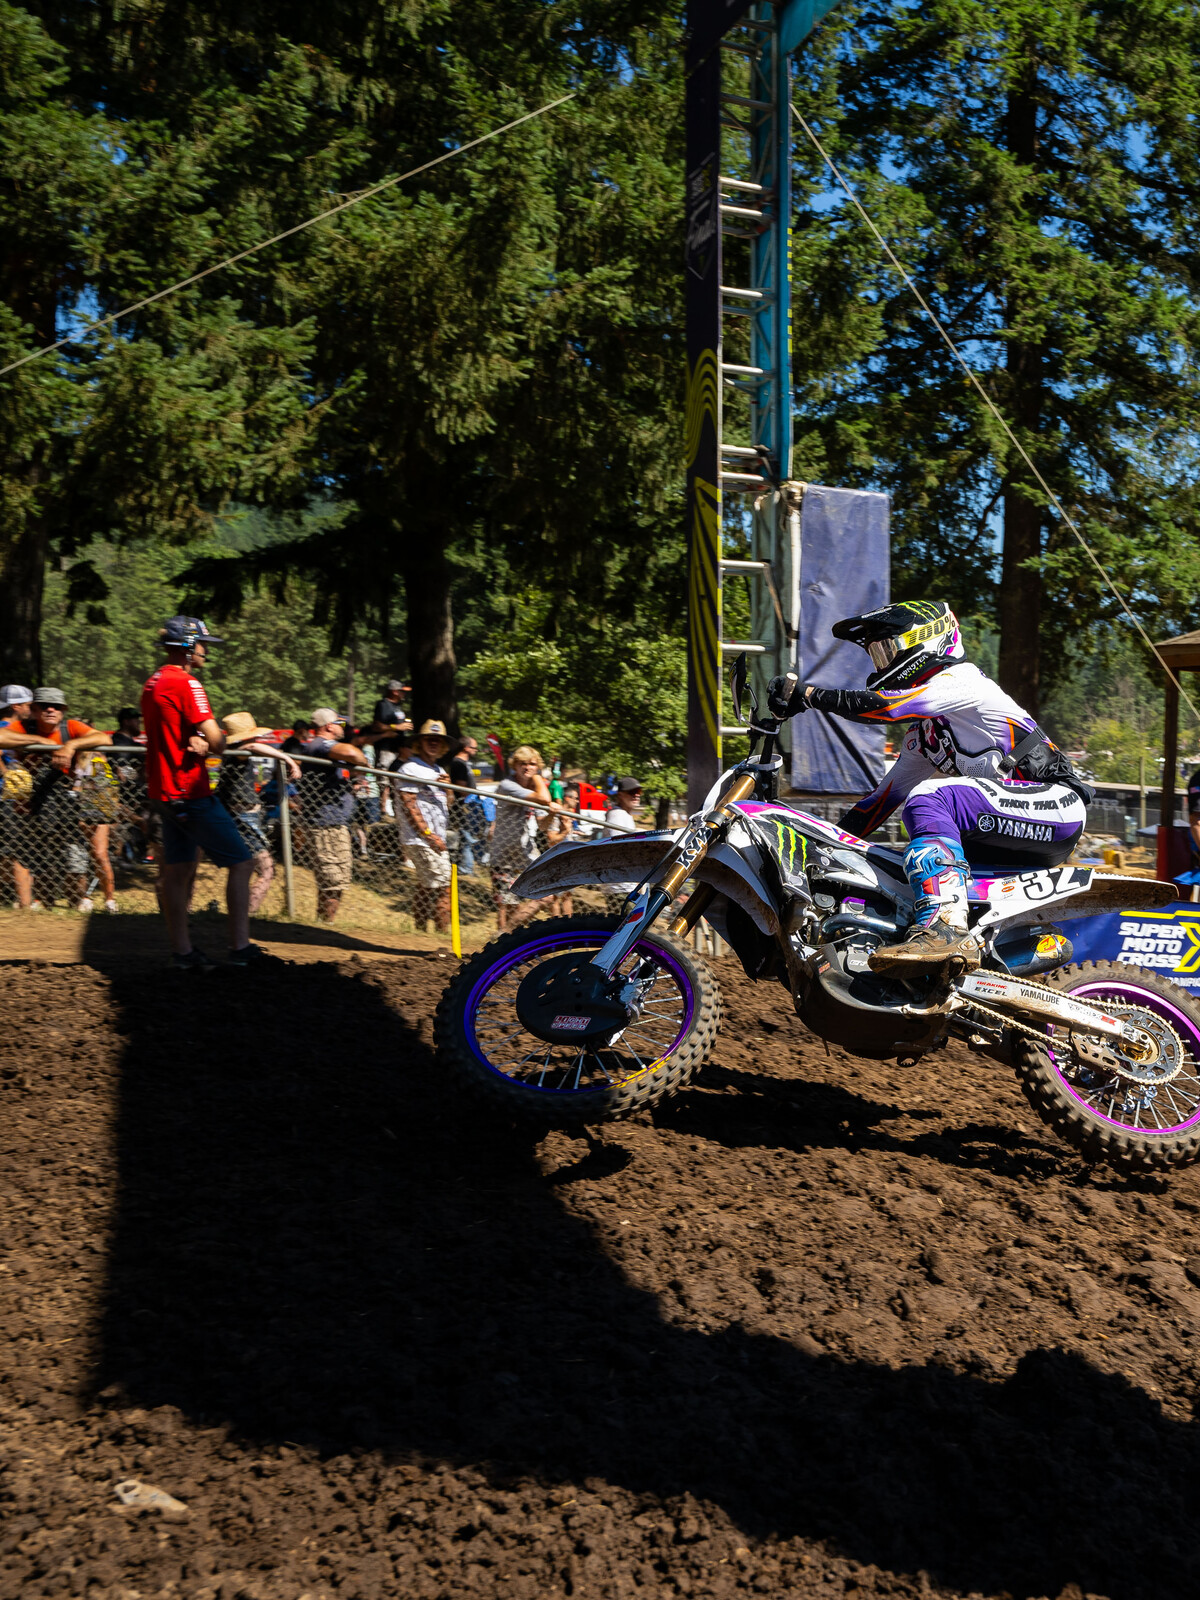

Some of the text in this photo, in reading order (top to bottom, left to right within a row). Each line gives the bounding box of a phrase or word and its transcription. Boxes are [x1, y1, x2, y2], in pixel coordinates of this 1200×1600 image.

[907, 614, 956, 647] 100%
[897, 654, 929, 680] MONSTER
[996, 818, 1054, 842] YAMAHA
[1019, 867, 1081, 900] 32
[1118, 921, 1187, 940] SUPER
[1121, 936, 1183, 954] MOTO
[1117, 951, 1183, 969] CROSS
[974, 986, 1008, 997] EXCEL
[976, 980, 1008, 990] BRAKING
[1020, 988, 1060, 1006] YAMALUBE
